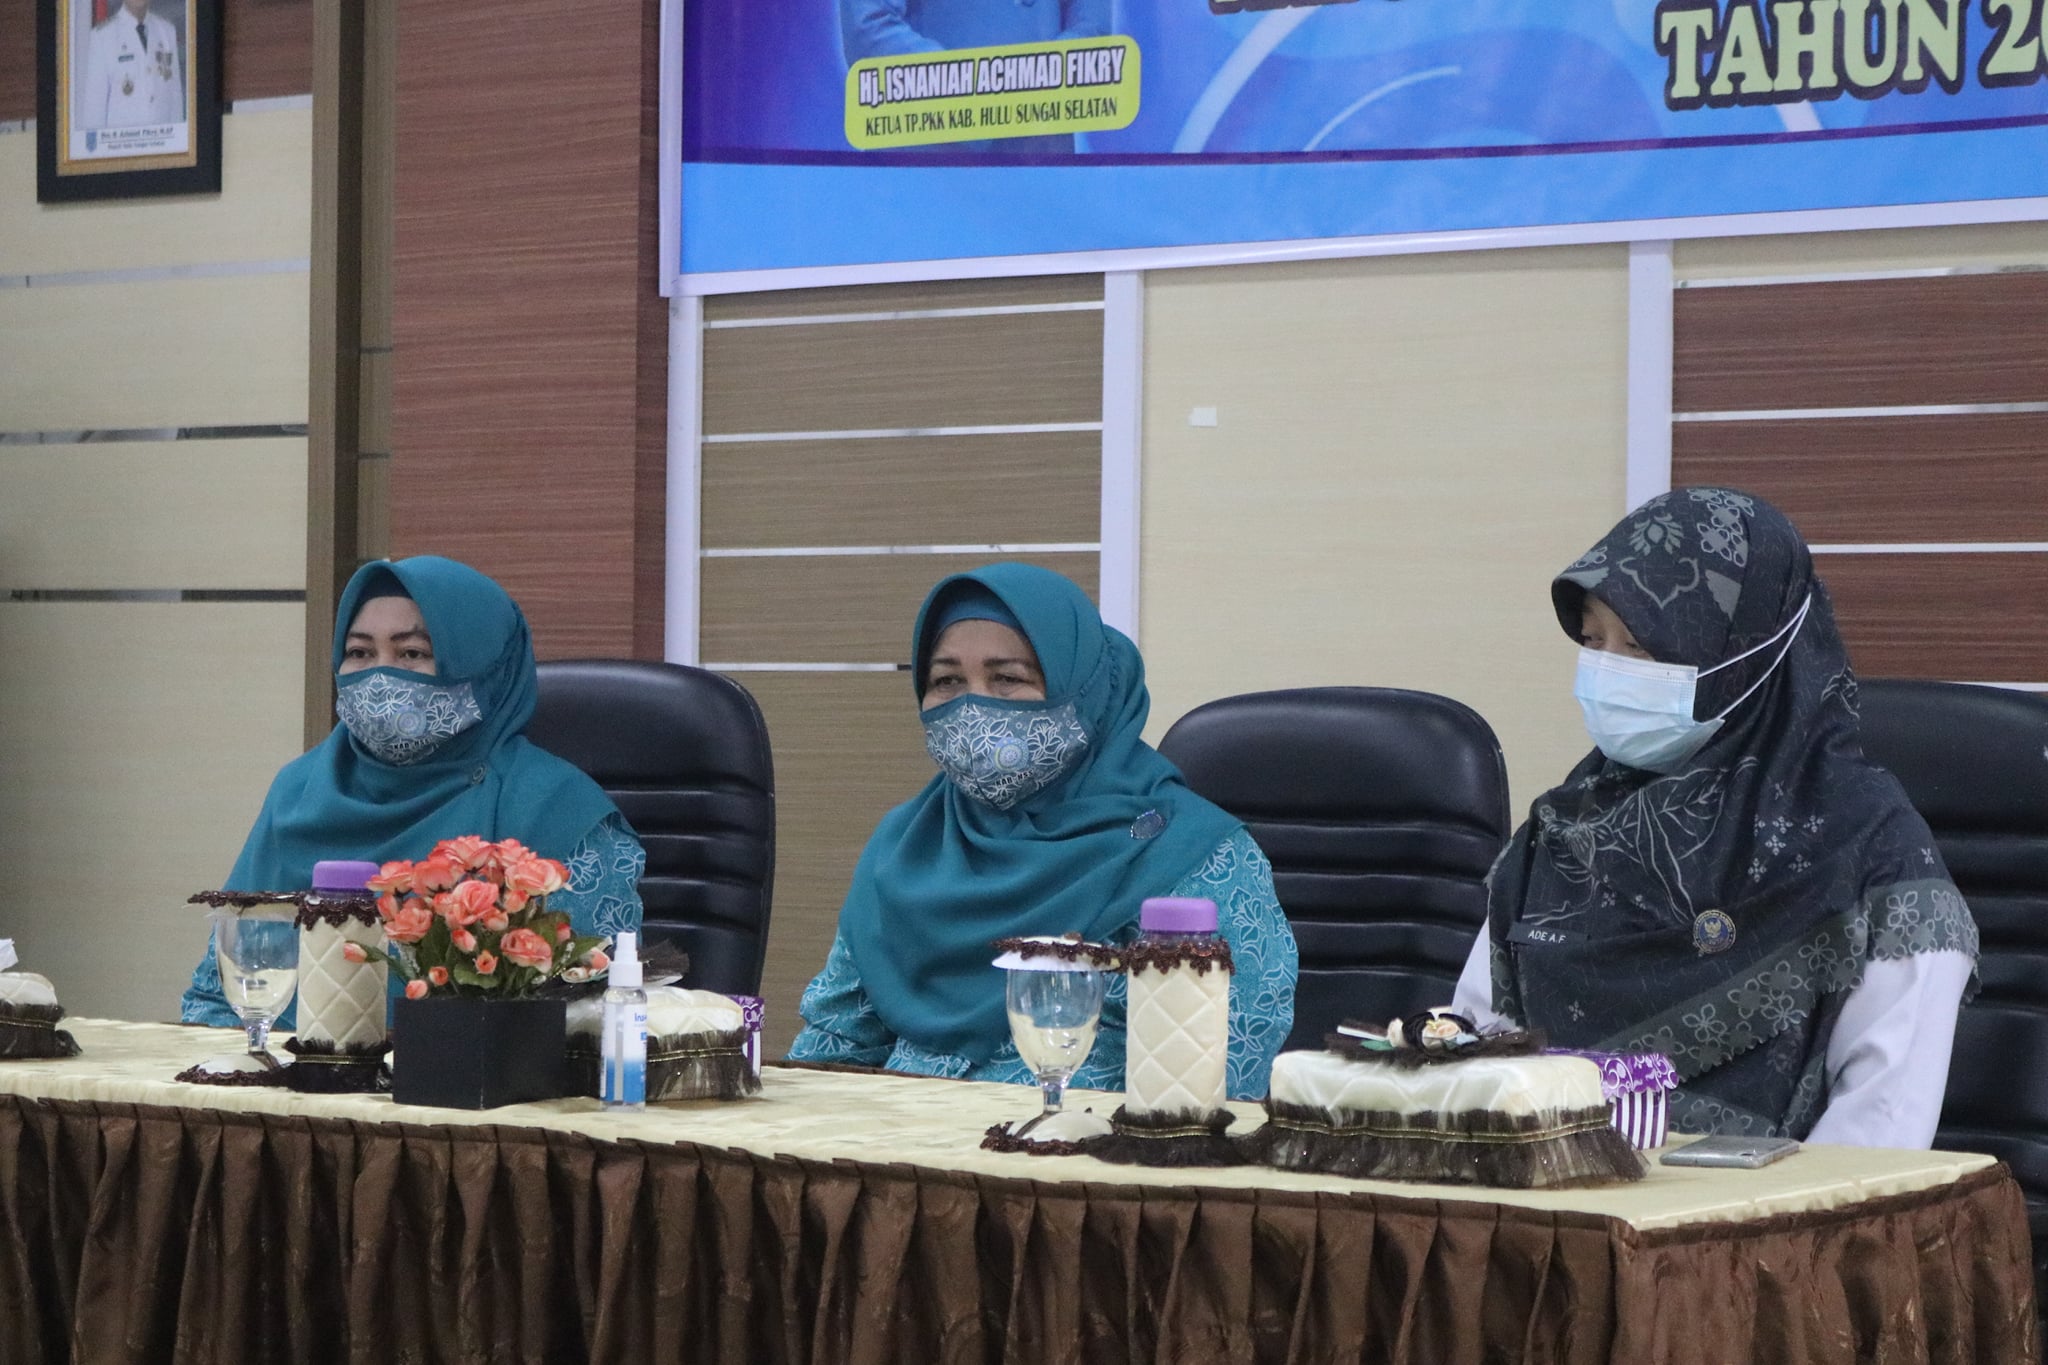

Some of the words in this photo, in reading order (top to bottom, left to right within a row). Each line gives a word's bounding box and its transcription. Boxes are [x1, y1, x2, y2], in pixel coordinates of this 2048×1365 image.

[859, 68, 884, 108] Hj.
[884, 59, 975, 103] ISNANIAH
[976, 51, 1064, 95] ACHMAD
[1065, 45, 1126, 88] FIKRY
[1657, 0, 1964, 109] TAHUN
[866, 114, 902, 136] KETUA
[904, 110, 945, 133] TP.PKK
[949, 108, 976, 129] KAB.
[980, 105, 1012, 126] HULU
[1016, 100, 1061, 124] SUNGAI
[1064, 97, 1118, 120] SELATAN
[1527, 929, 1548, 942] ADE
